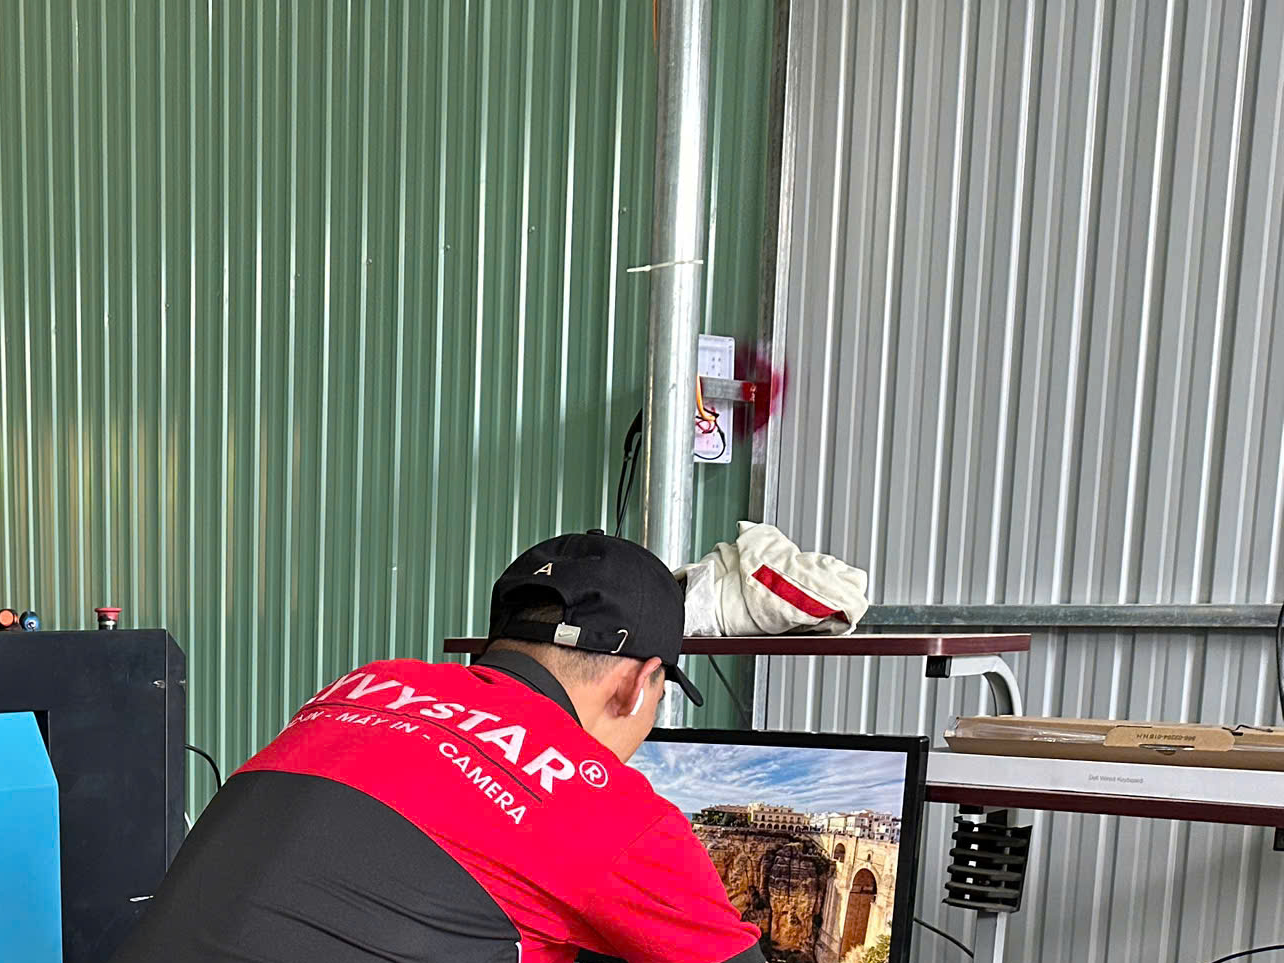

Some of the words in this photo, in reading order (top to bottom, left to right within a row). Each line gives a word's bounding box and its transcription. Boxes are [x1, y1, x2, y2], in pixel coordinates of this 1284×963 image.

[335, 711, 389, 727] MÁY
[389, 720, 420, 734] IN
[438, 741, 528, 825] CAMERA
